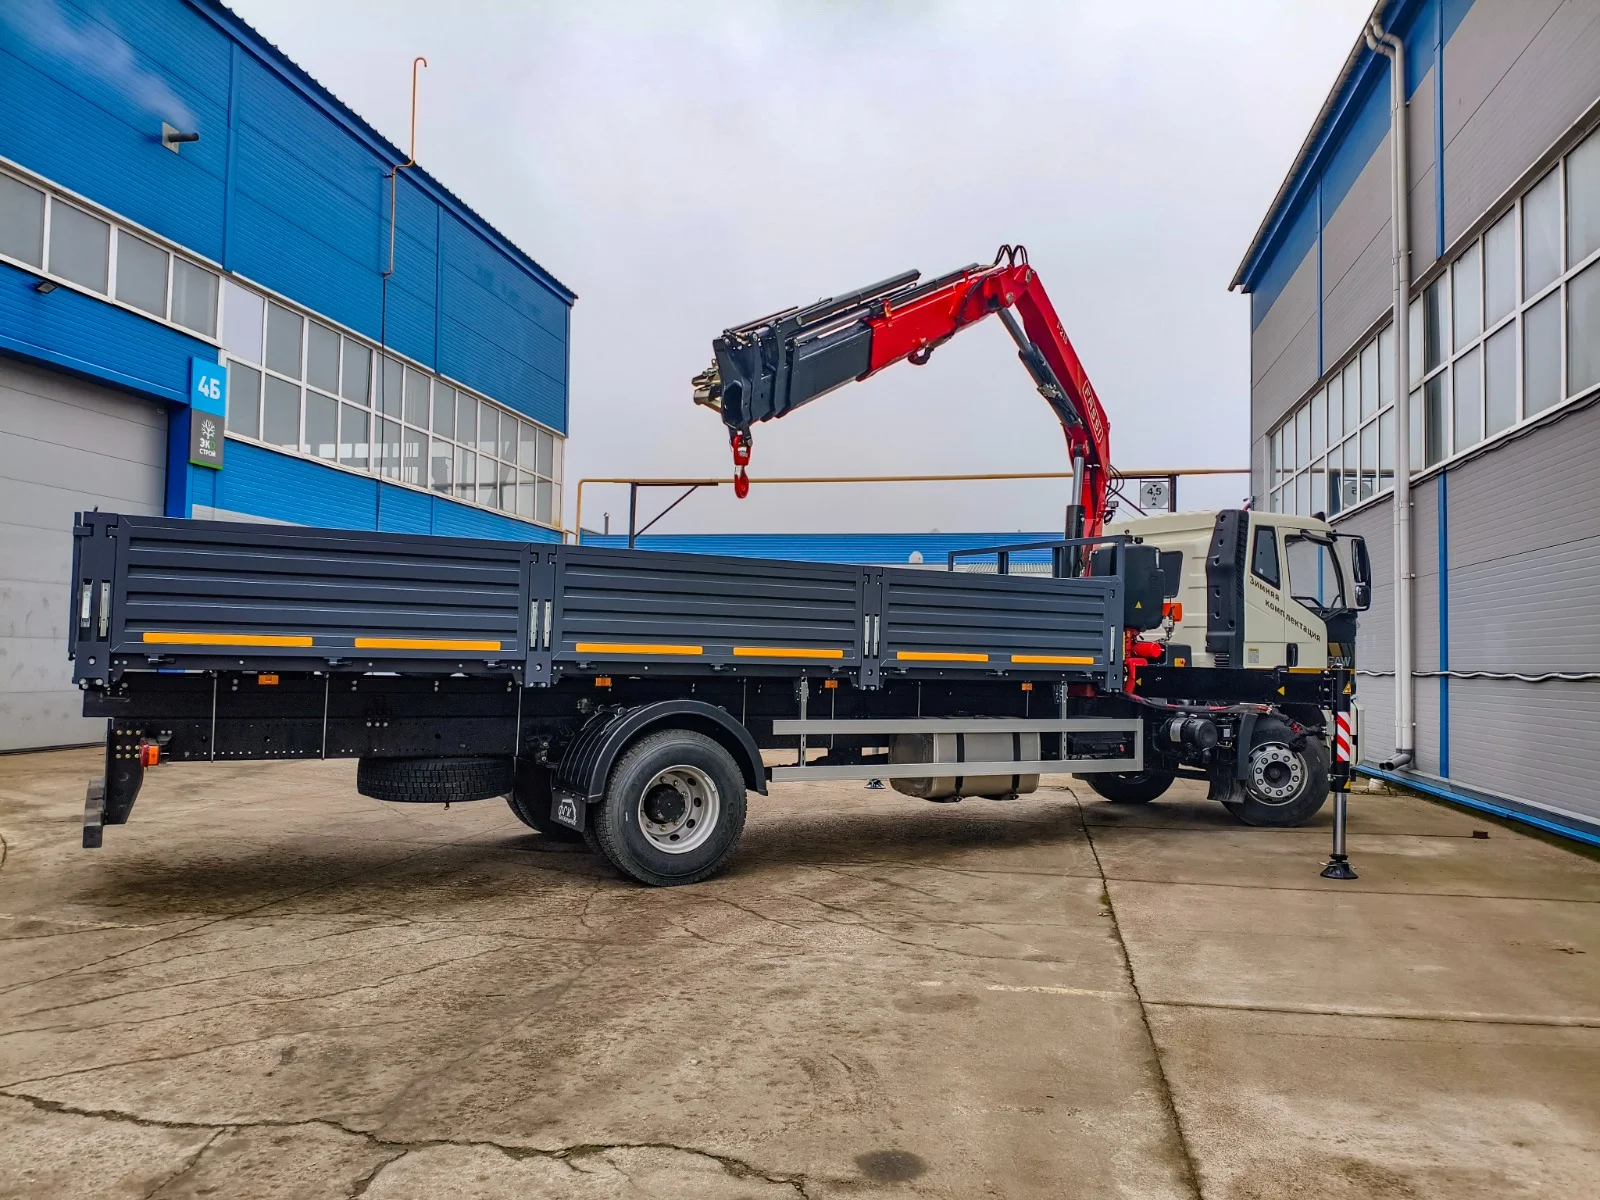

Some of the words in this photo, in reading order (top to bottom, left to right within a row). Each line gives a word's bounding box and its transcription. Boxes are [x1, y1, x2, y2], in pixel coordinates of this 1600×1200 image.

[199, 437, 216, 451] ЭКО
[199, 448, 217, 458] СТРОЙ
[1249, 575, 1280, 602] Зимняя
[1265, 599, 1321, 642] комплектация
[1328, 656, 1351, 667] FAW
